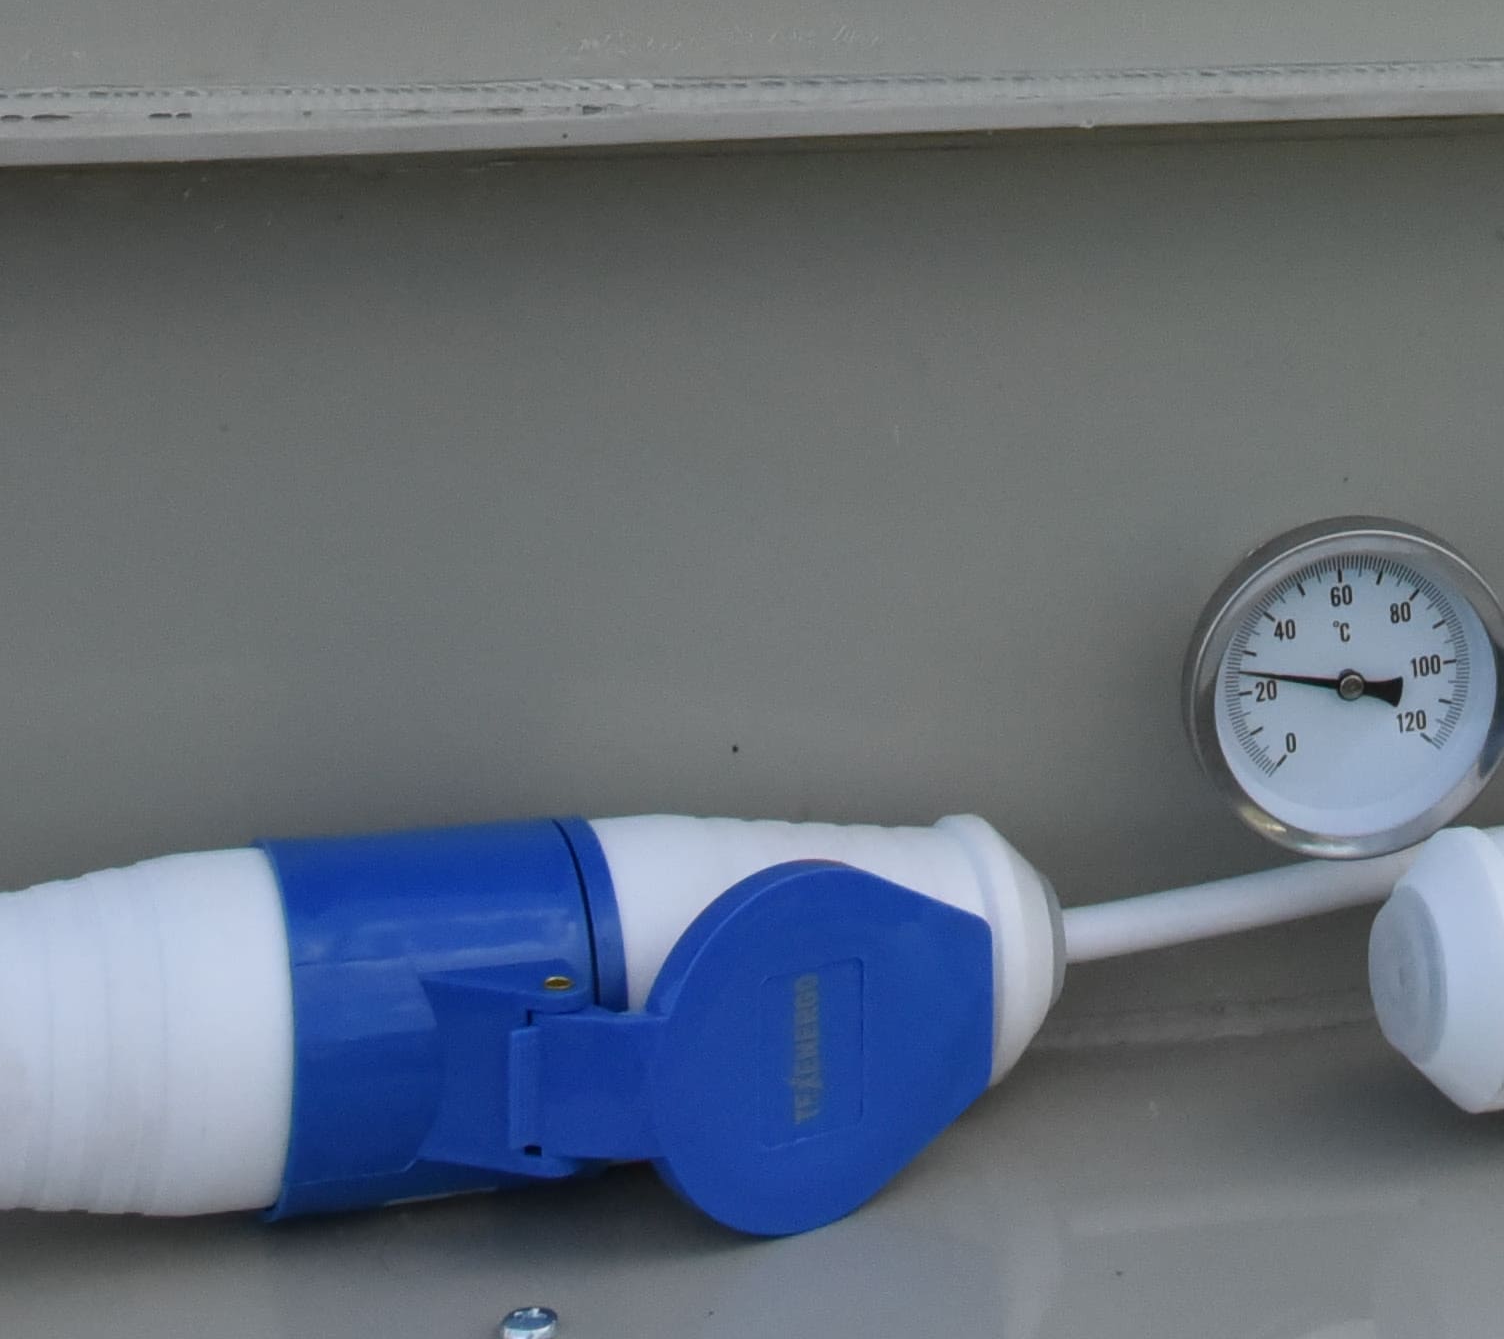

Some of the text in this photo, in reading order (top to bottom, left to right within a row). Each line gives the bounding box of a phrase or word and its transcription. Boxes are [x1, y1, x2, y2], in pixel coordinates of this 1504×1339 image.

[1329, 585, 1353, 608] 60
[1389, 602, 1412, 624] 80
[1273, 619, 1296, 642] 40
[1411, 654, 1441, 678] 100
[1255, 680, 1277, 703] 20
[1397, 709, 1427, 734] 120
[1285, 732, 1297, 753] 0
